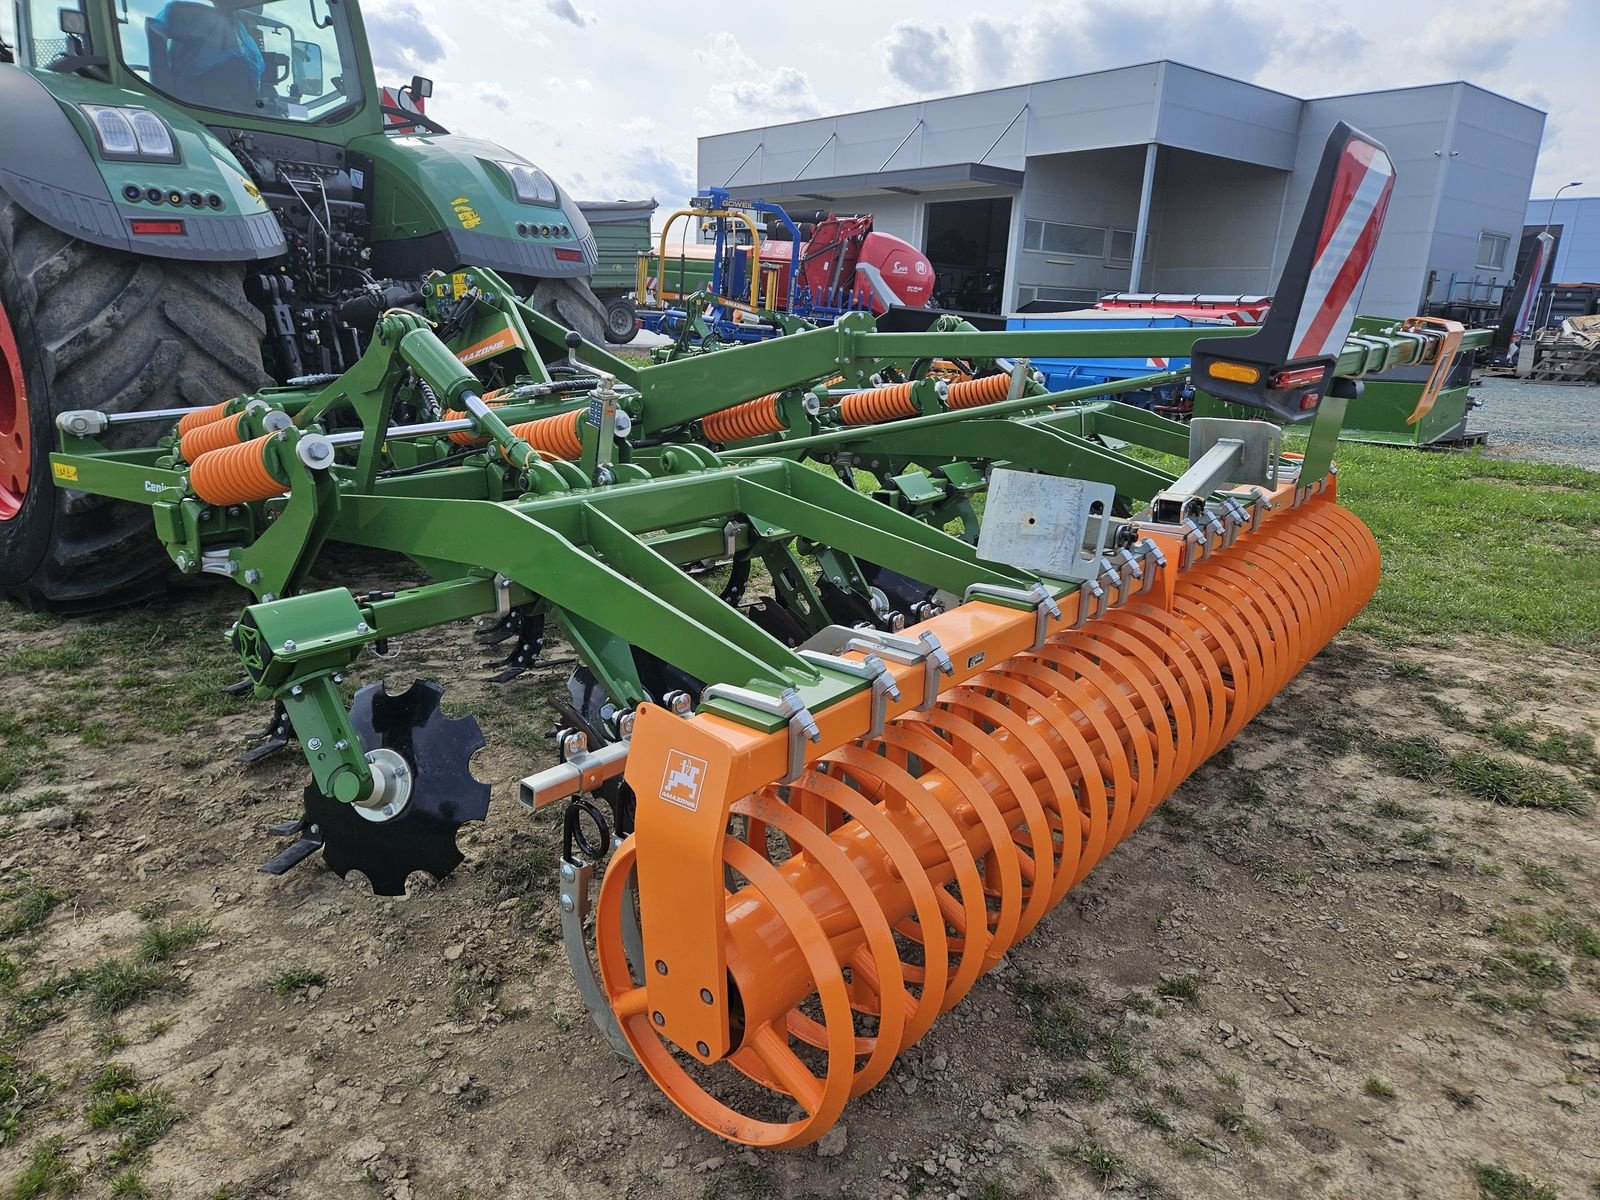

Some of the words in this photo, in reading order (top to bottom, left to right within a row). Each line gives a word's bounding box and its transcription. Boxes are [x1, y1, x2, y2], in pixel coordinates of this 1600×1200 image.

[458, 339, 505, 364] MAZONE
[144, 480, 167, 493] Ceni
[661, 791, 696, 809] AMAZONE
